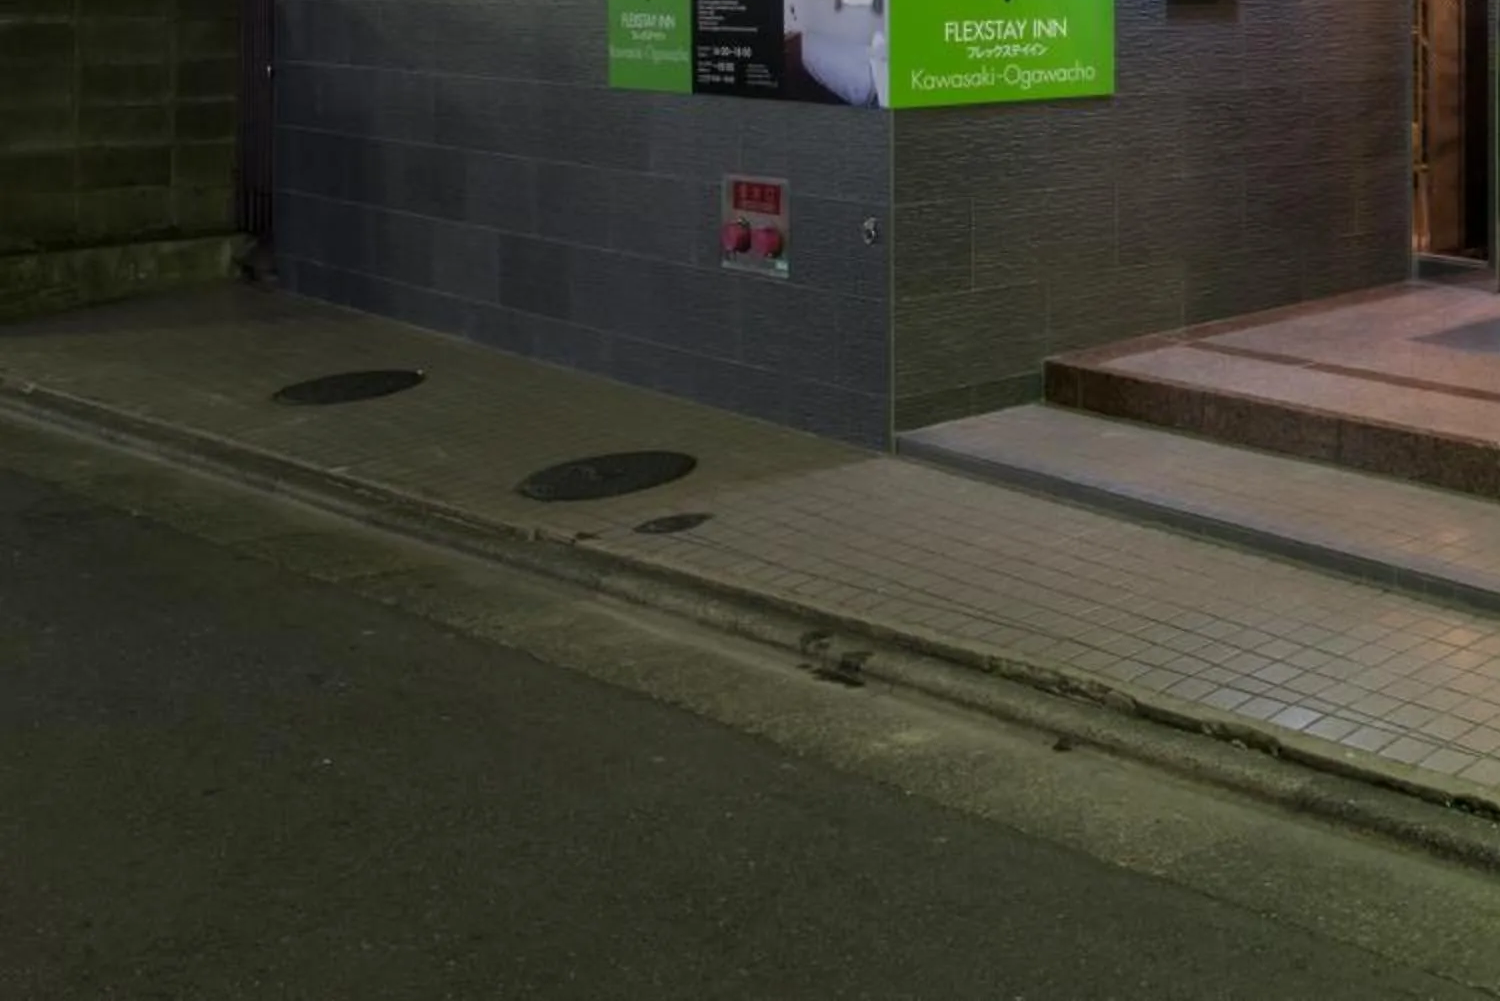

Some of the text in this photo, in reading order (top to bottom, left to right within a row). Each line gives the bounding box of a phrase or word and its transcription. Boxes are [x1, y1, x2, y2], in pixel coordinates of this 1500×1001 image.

[944, 16, 1067, 42] FLEXSTAY INN
[911, 59, 1097, 90] Kawasaki-Ogawacho
